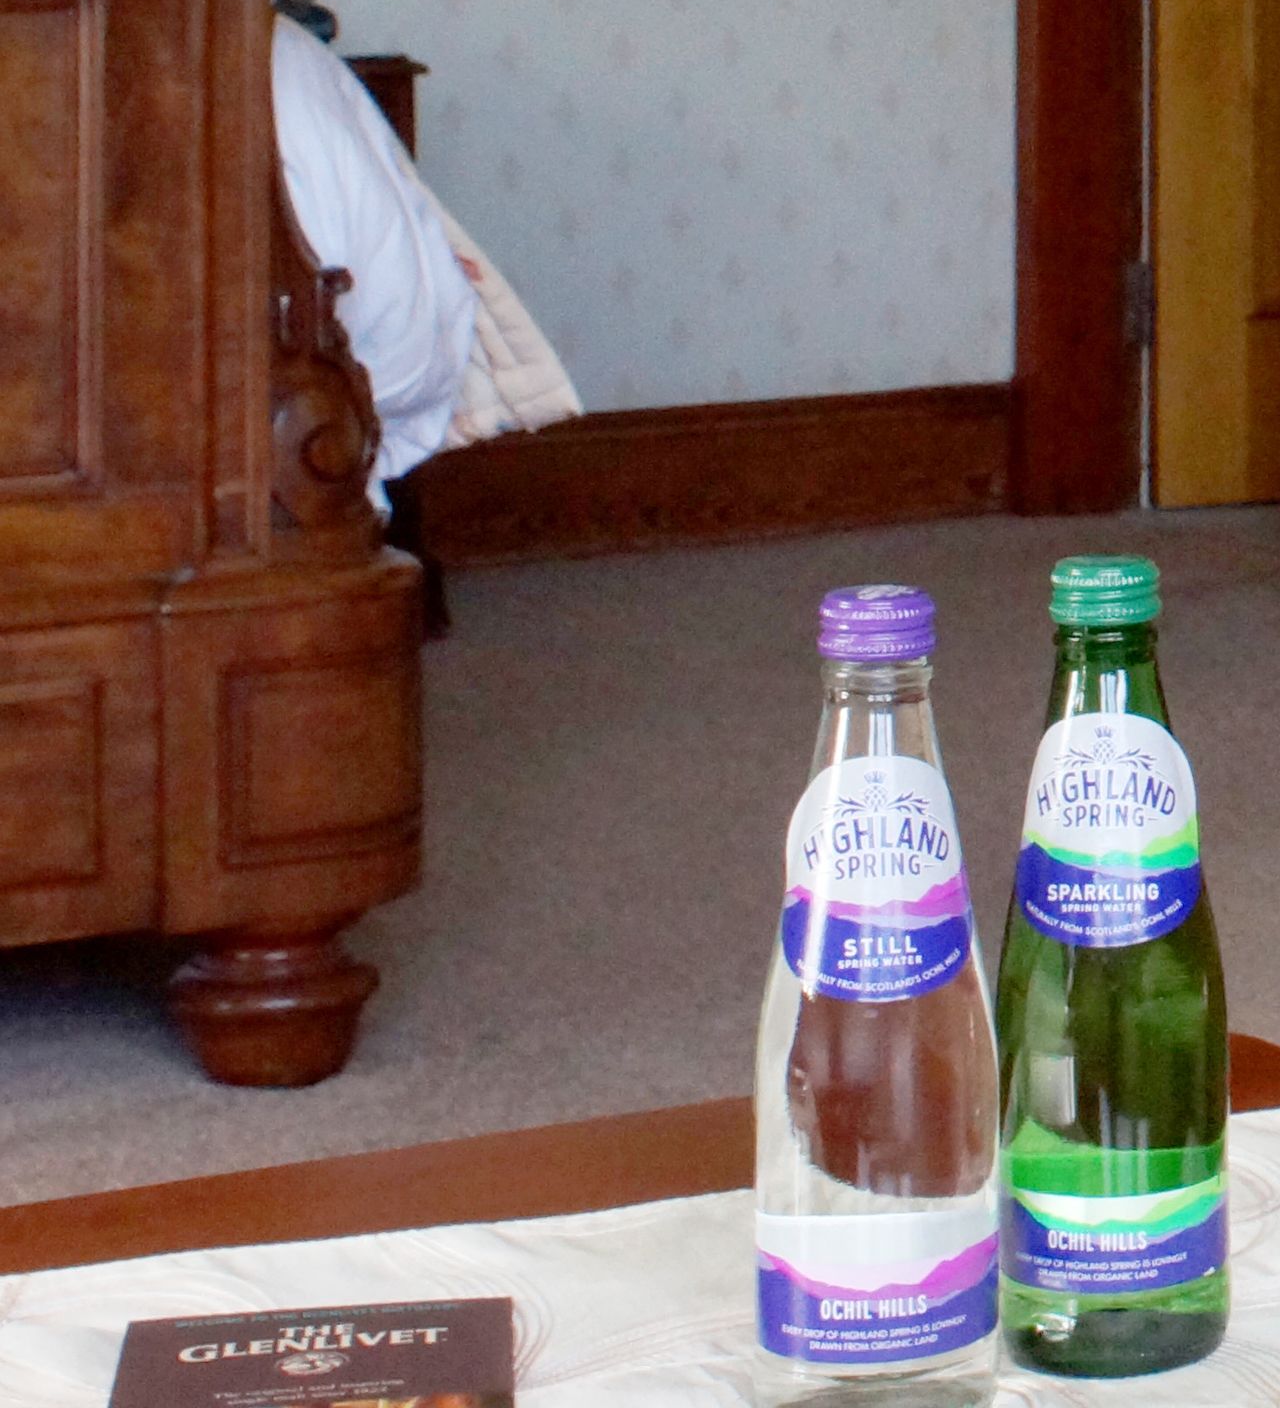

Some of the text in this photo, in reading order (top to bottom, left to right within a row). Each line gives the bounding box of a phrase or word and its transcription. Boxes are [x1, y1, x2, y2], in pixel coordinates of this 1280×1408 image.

[1036, 769, 1176, 816] HIGHLAND
[1063, 804, 1144, 827] SPRING
[803, 816, 949, 871] HGHLAND
[835, 852, 921, 880] SPRING
[1047, 883, 1159, 901] SPARKLING
[1061, 902, 1141, 913] SPRING WATER
[1060, 921, 1083, 934] FROM
[844, 935, 917, 957] STILL
[838, 955, 922, 970] SPRING WATER
[837, 977, 863, 990] FROM
[1048, 1230, 1147, 1251] OCHIL HILLS
[1065, 1260, 1109, 1270] HIGHLAND
[1069, 1271, 1091, 1281] FROM
[1093, 1271, 1134, 1281] ORGANIC
[1135, 1269, 1158, 1279] LAND
[820, 1295, 928, 1320] OCHIL HILLS
[279, 1323, 354, 1338] THE
[826, 1329, 839, 1339] OF
[840, 1328, 888, 1340] HIGHLAND
[890, 1325, 921, 1338] SPRING
[178, 1327, 448, 1362] GLENLIVET
[809, 1333, 938, 1351] DRAWN FROM ORGANIC LAND
